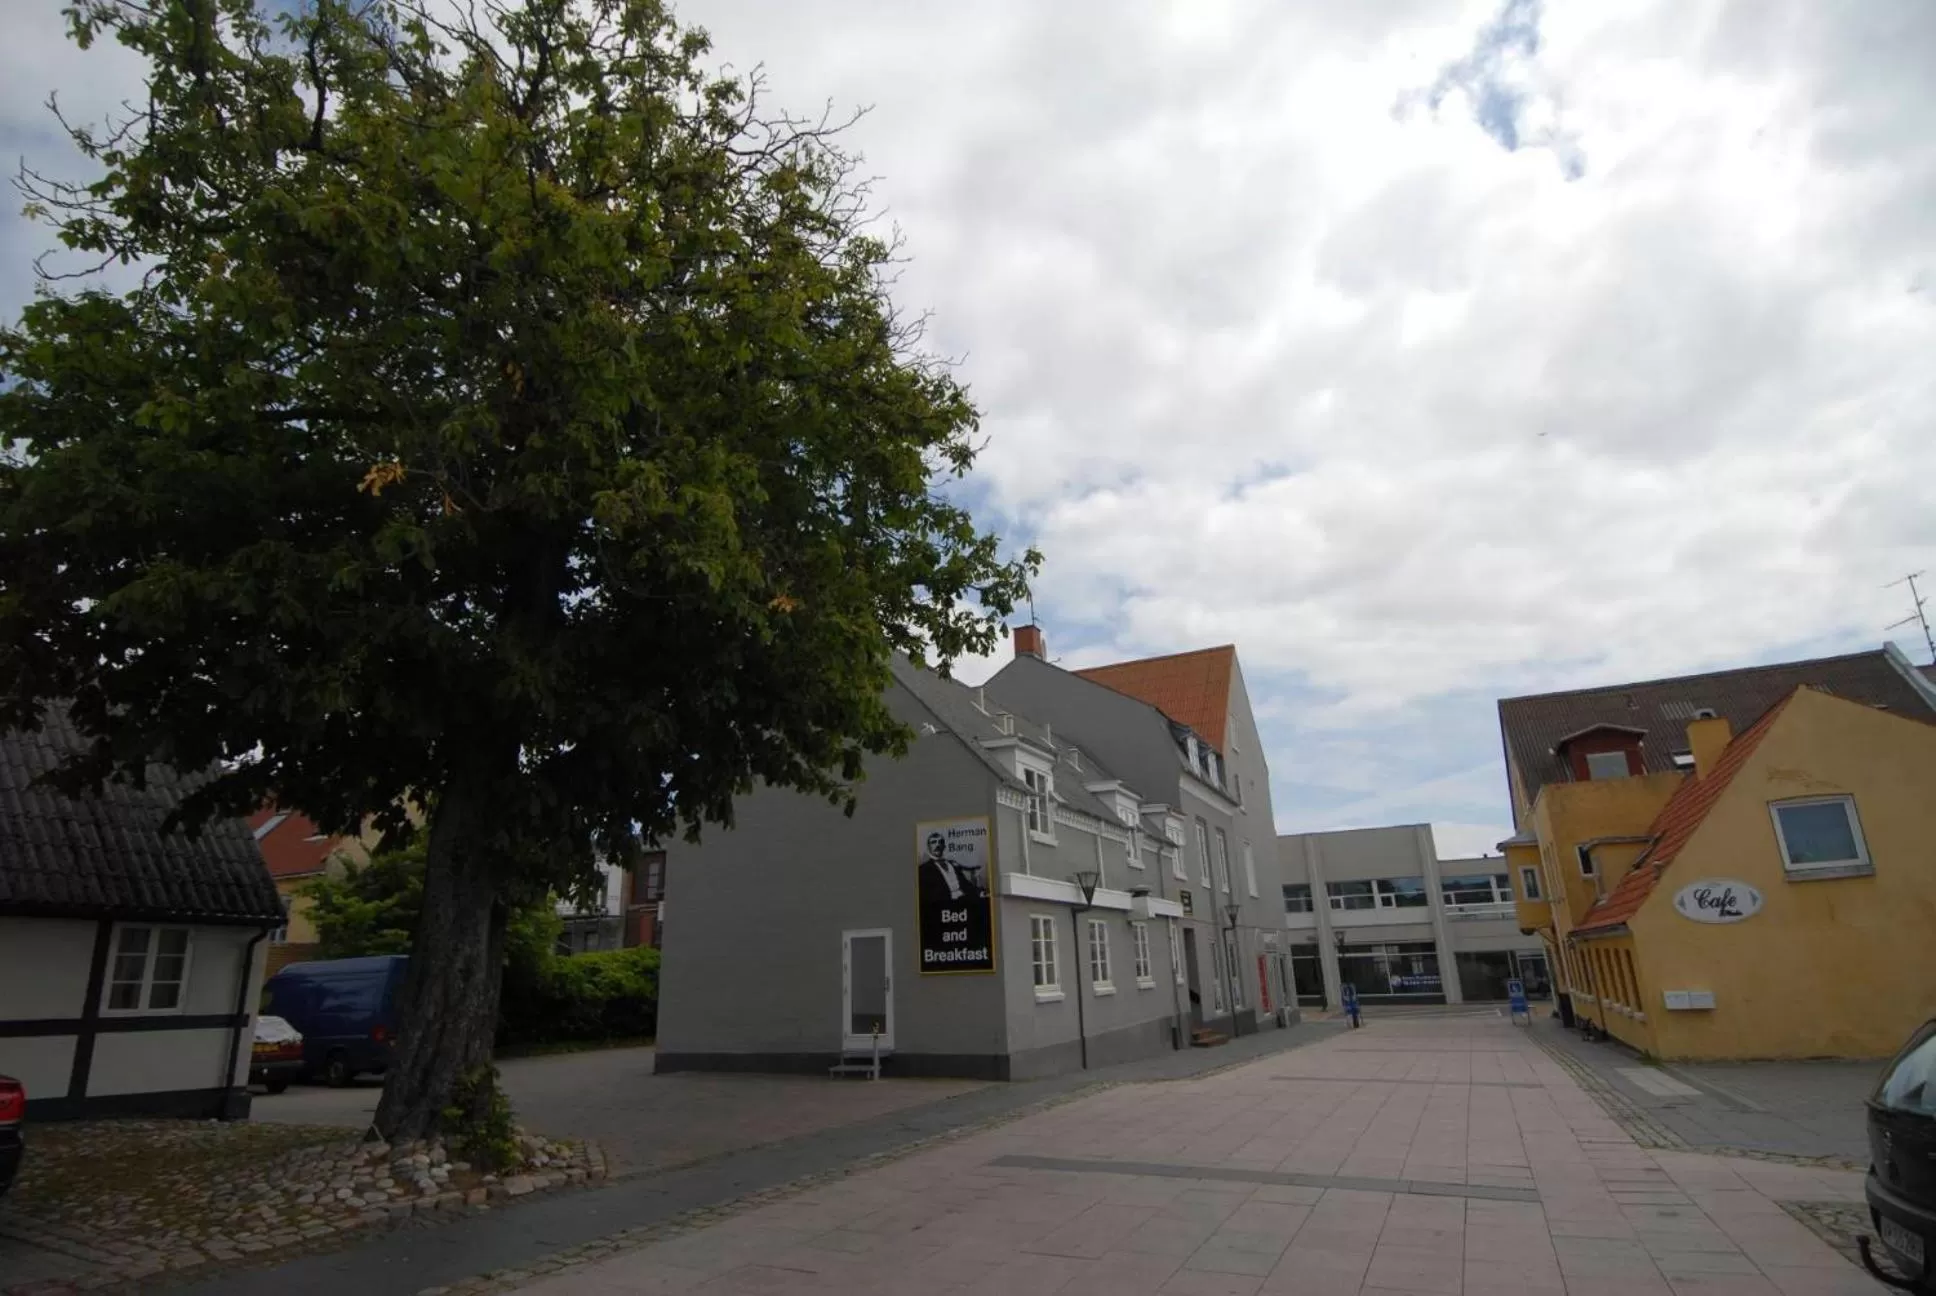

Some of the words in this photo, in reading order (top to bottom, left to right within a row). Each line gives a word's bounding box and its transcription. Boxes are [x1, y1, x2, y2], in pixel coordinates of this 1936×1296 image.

[948, 826, 987, 839] Herman
[948, 842, 974, 853] Bang
[1693, 887, 1737, 912] Cafe
[941, 909, 968, 923] Bed
[942, 928, 968, 942] and
[924, 946, 989, 963] Breakfast
